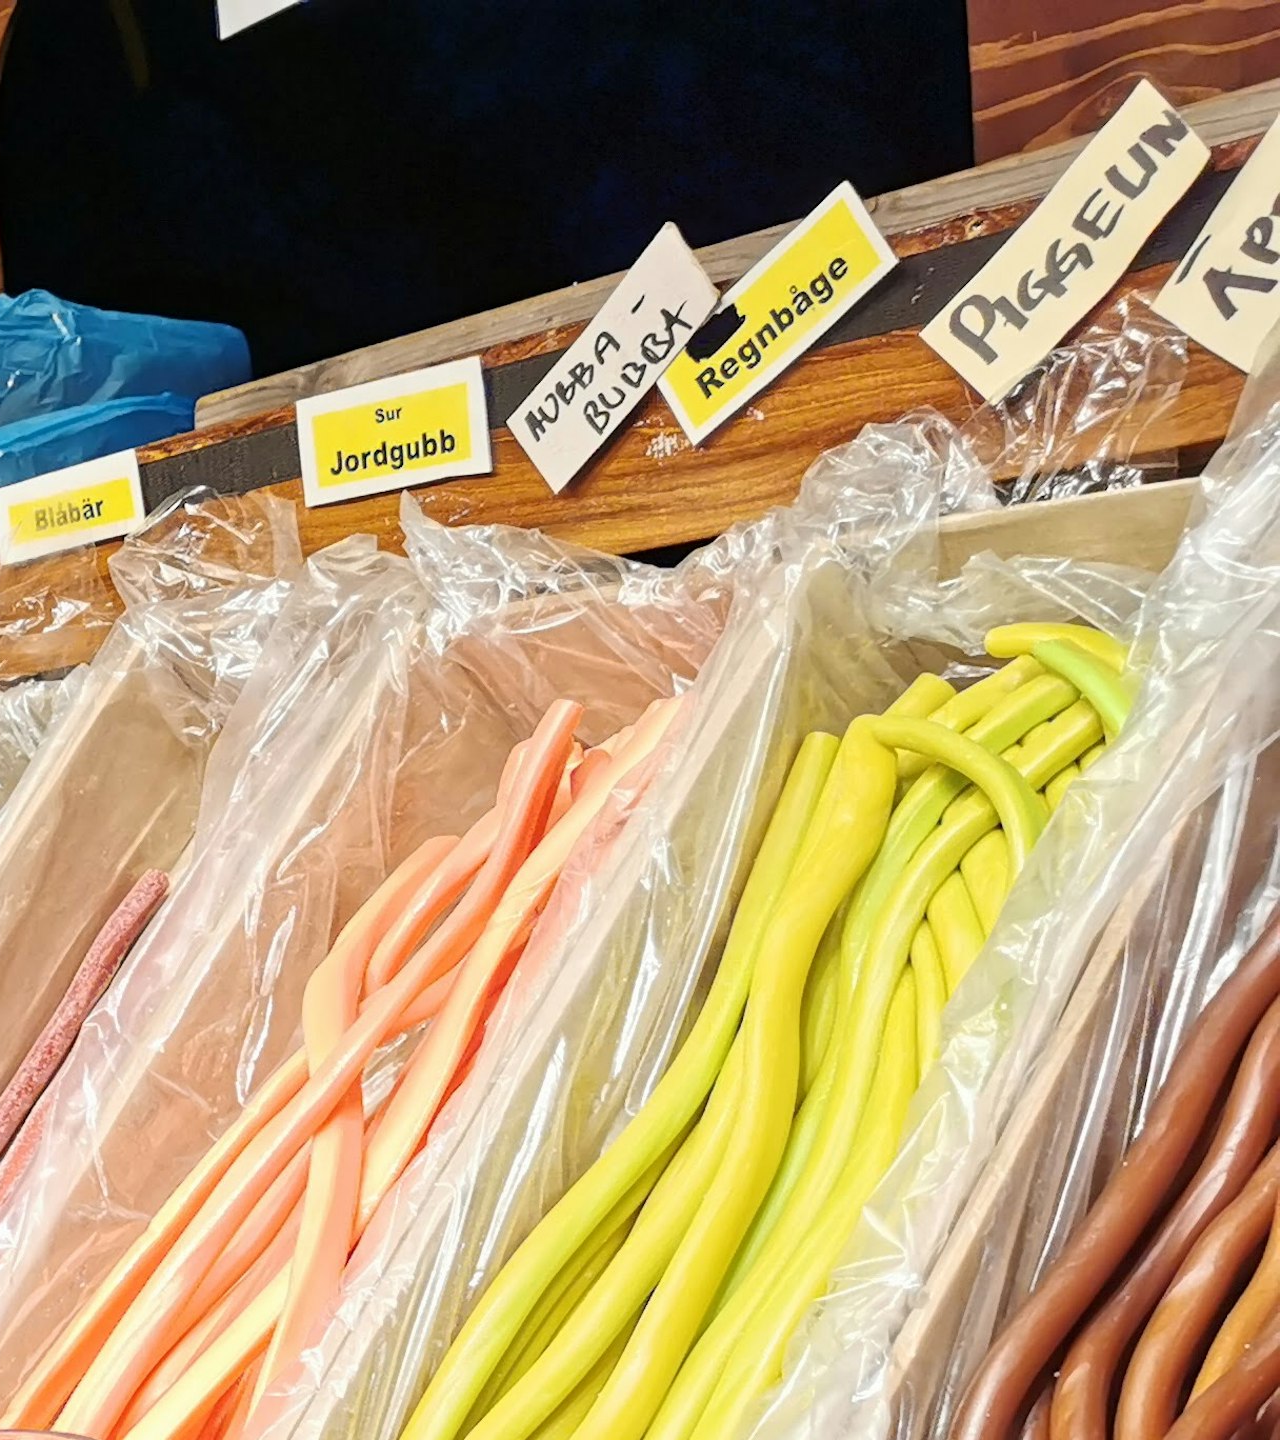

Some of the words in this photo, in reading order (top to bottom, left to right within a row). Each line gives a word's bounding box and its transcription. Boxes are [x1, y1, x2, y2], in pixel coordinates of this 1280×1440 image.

[694, 256, 849, 399] Regnbåge
[582, 300, 693, 436] BUBBA
[374, 406, 403, 424] Sur
[330, 429, 456, 476] Jordgubb
[34, 498, 104, 531] Blåbär
